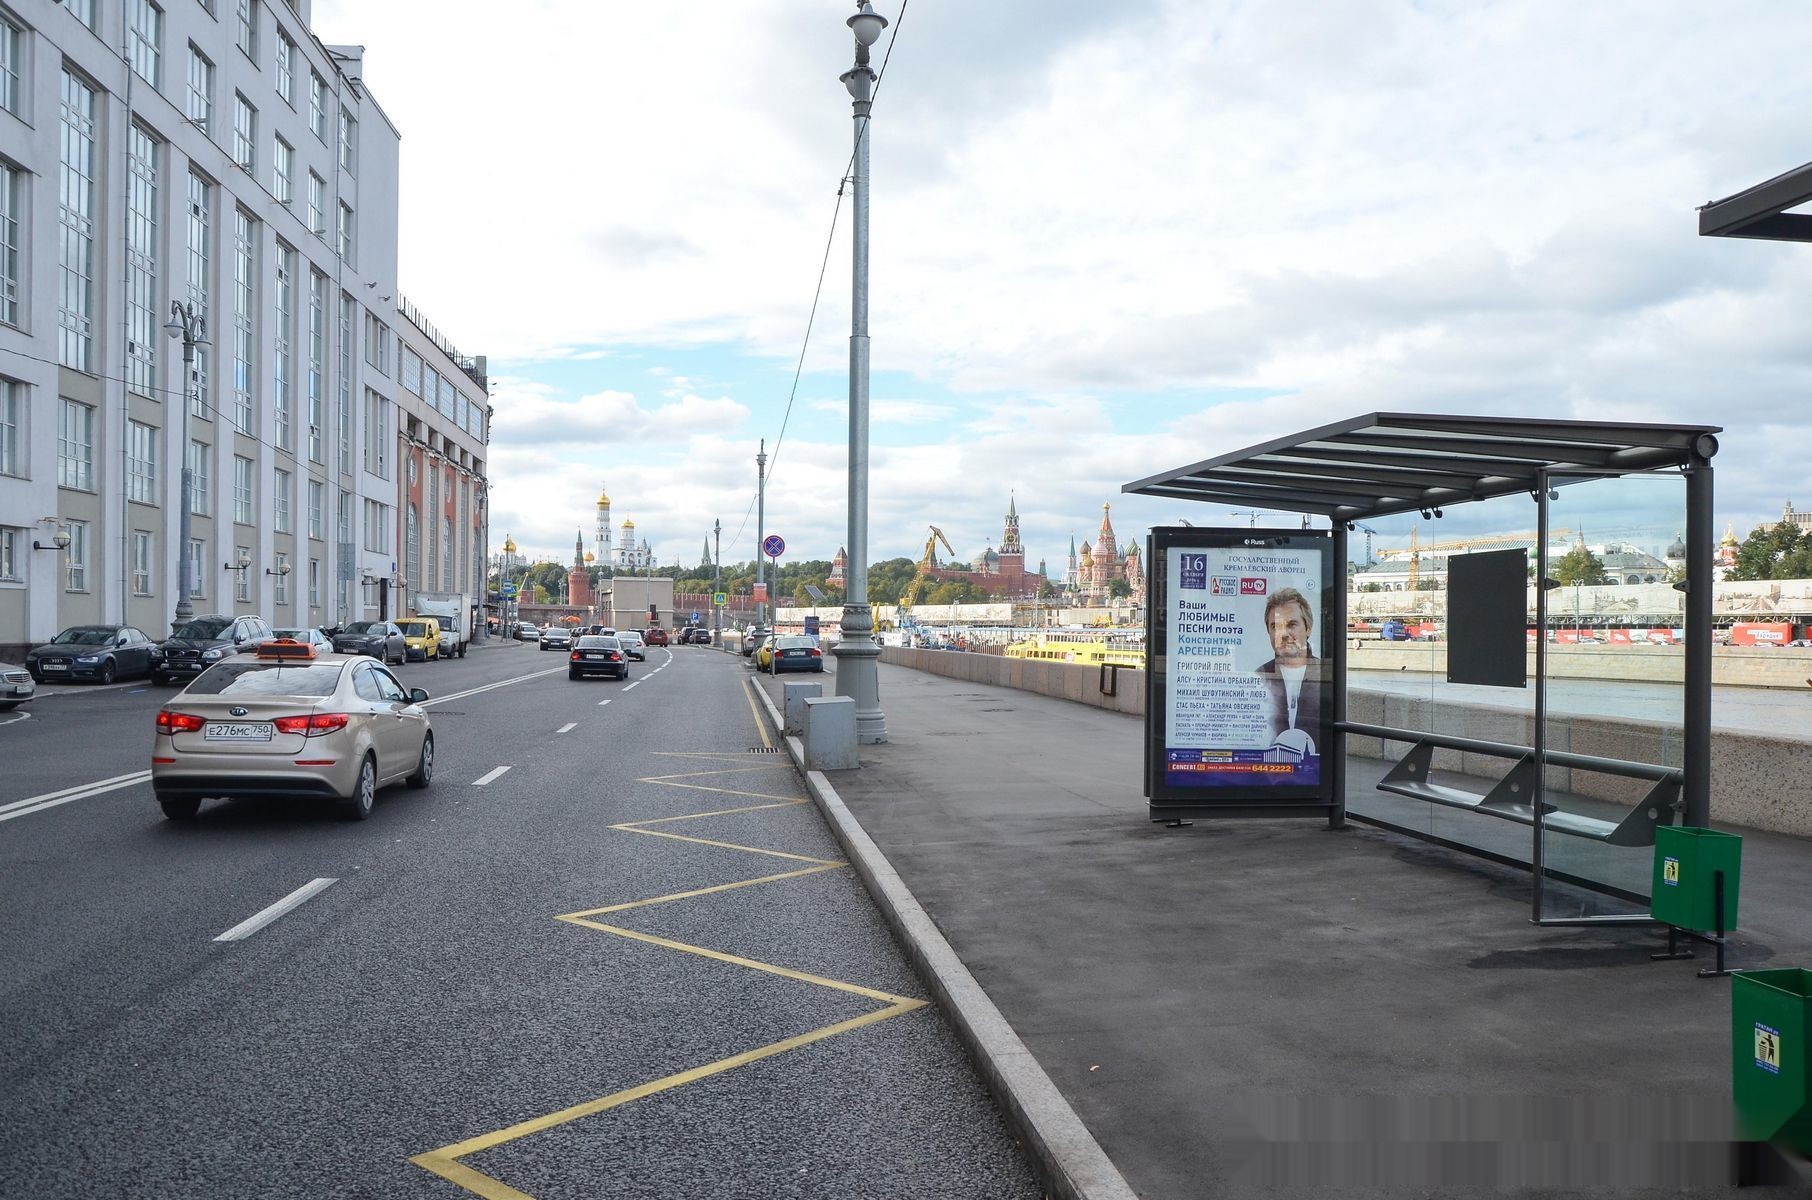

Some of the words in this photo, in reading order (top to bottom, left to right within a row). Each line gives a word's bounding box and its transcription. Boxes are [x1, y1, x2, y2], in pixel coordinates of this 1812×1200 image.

[1184, 556, 1204, 571] 16
[1229, 556, 1300, 565] ГОСУДАРСТВЕННЫЙ
[1242, 581, 1254, 589] RU
[1179, 600, 1207, 610] Ваши
[1178, 612, 1236, 622] ЛЮБИМЫЕ
[1178, 624, 1213, 633] ПЕСНИ
[1215, 626, 1243, 634] поэта
[1178, 635, 1242, 645] Константина
[1178, 646, 1232, 656] АРСЕНЕВА
[1177, 662, 1211, 671] ГРИГОРИЙ
[1214, 663, 1232, 671] ЛЕПС
[1197, 676, 1226, 684] КРИСТИНА
[1228, 677, 1261, 685] ОРБАКАЙТЕ
[252, 725, 269, 733] 750
